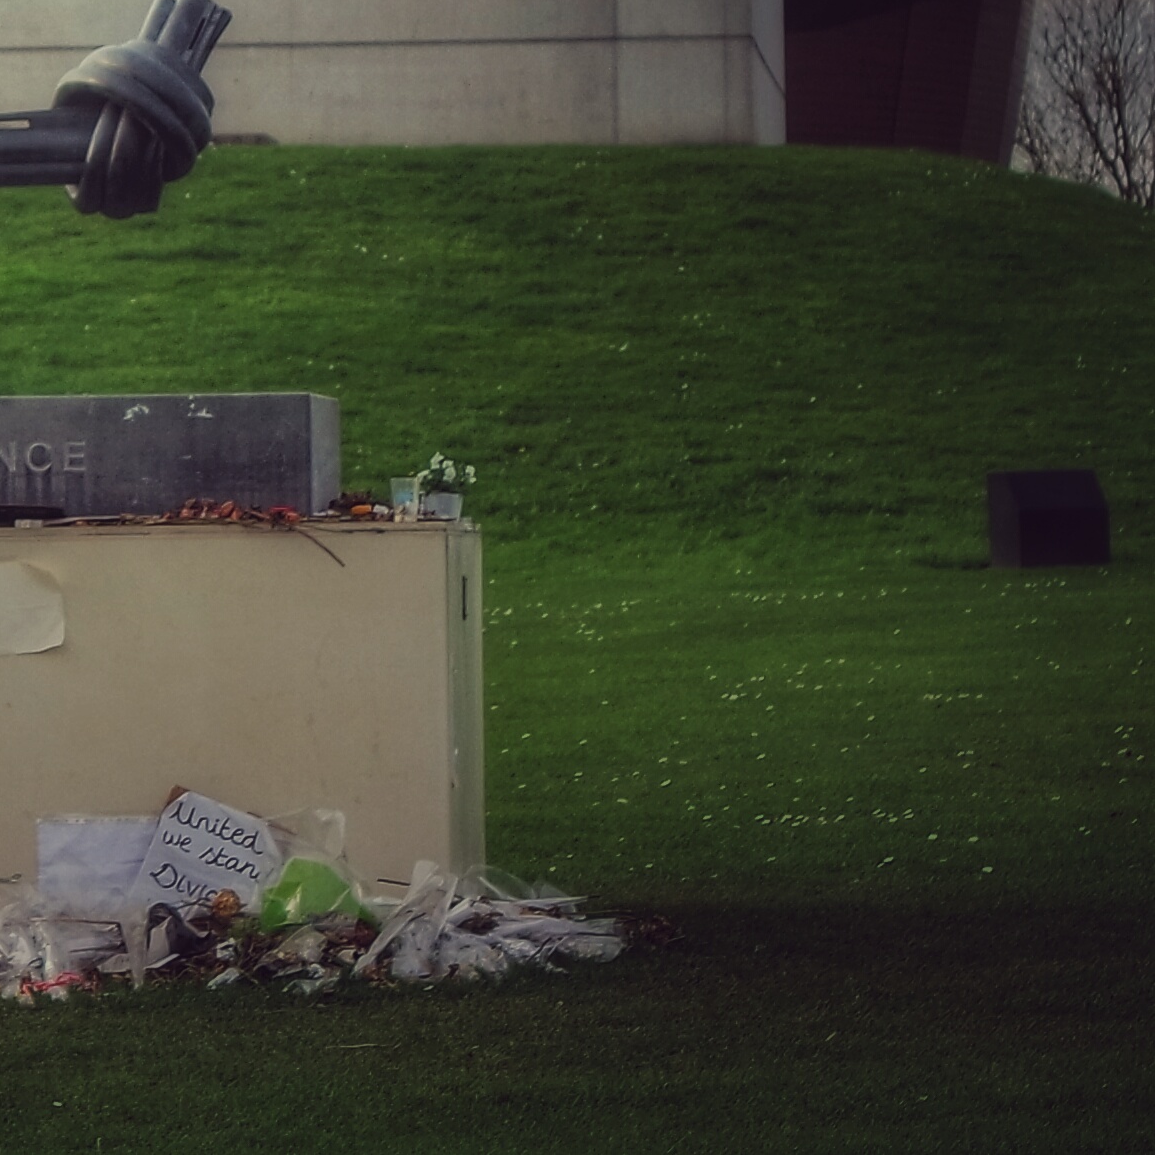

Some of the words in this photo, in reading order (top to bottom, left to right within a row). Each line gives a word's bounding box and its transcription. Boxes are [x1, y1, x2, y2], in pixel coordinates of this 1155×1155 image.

[169, 802, 264, 855] United
[163, 830, 191, 853] we
[198, 847, 262, 881] stan
